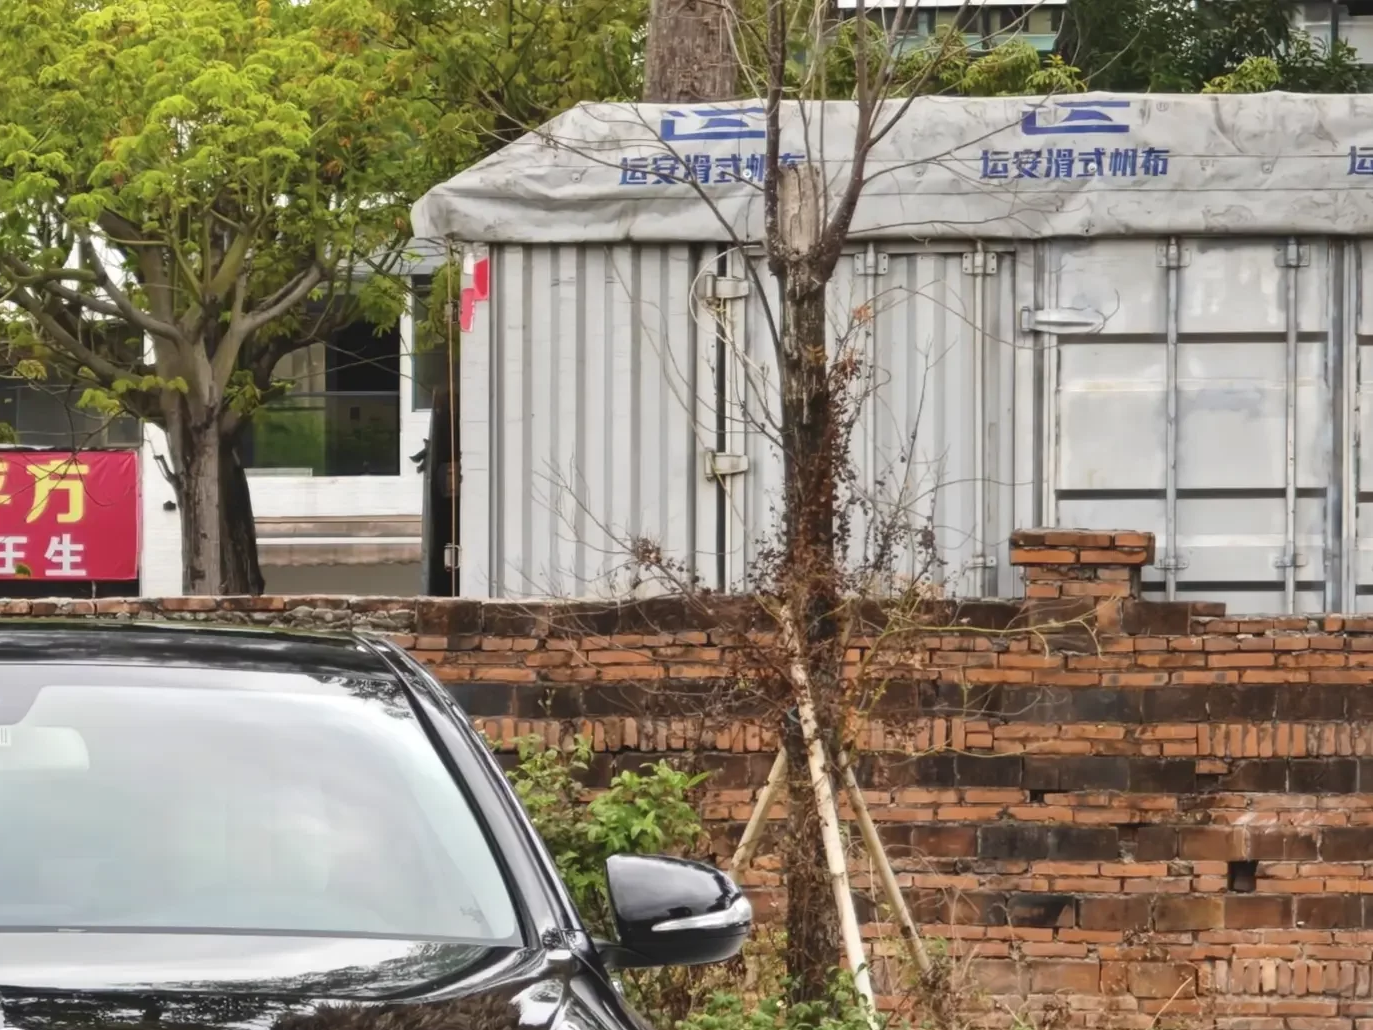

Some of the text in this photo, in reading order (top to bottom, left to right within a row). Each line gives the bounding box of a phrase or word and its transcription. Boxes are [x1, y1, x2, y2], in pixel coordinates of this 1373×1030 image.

[979, 147, 1171, 179] 运安滑式帆布
